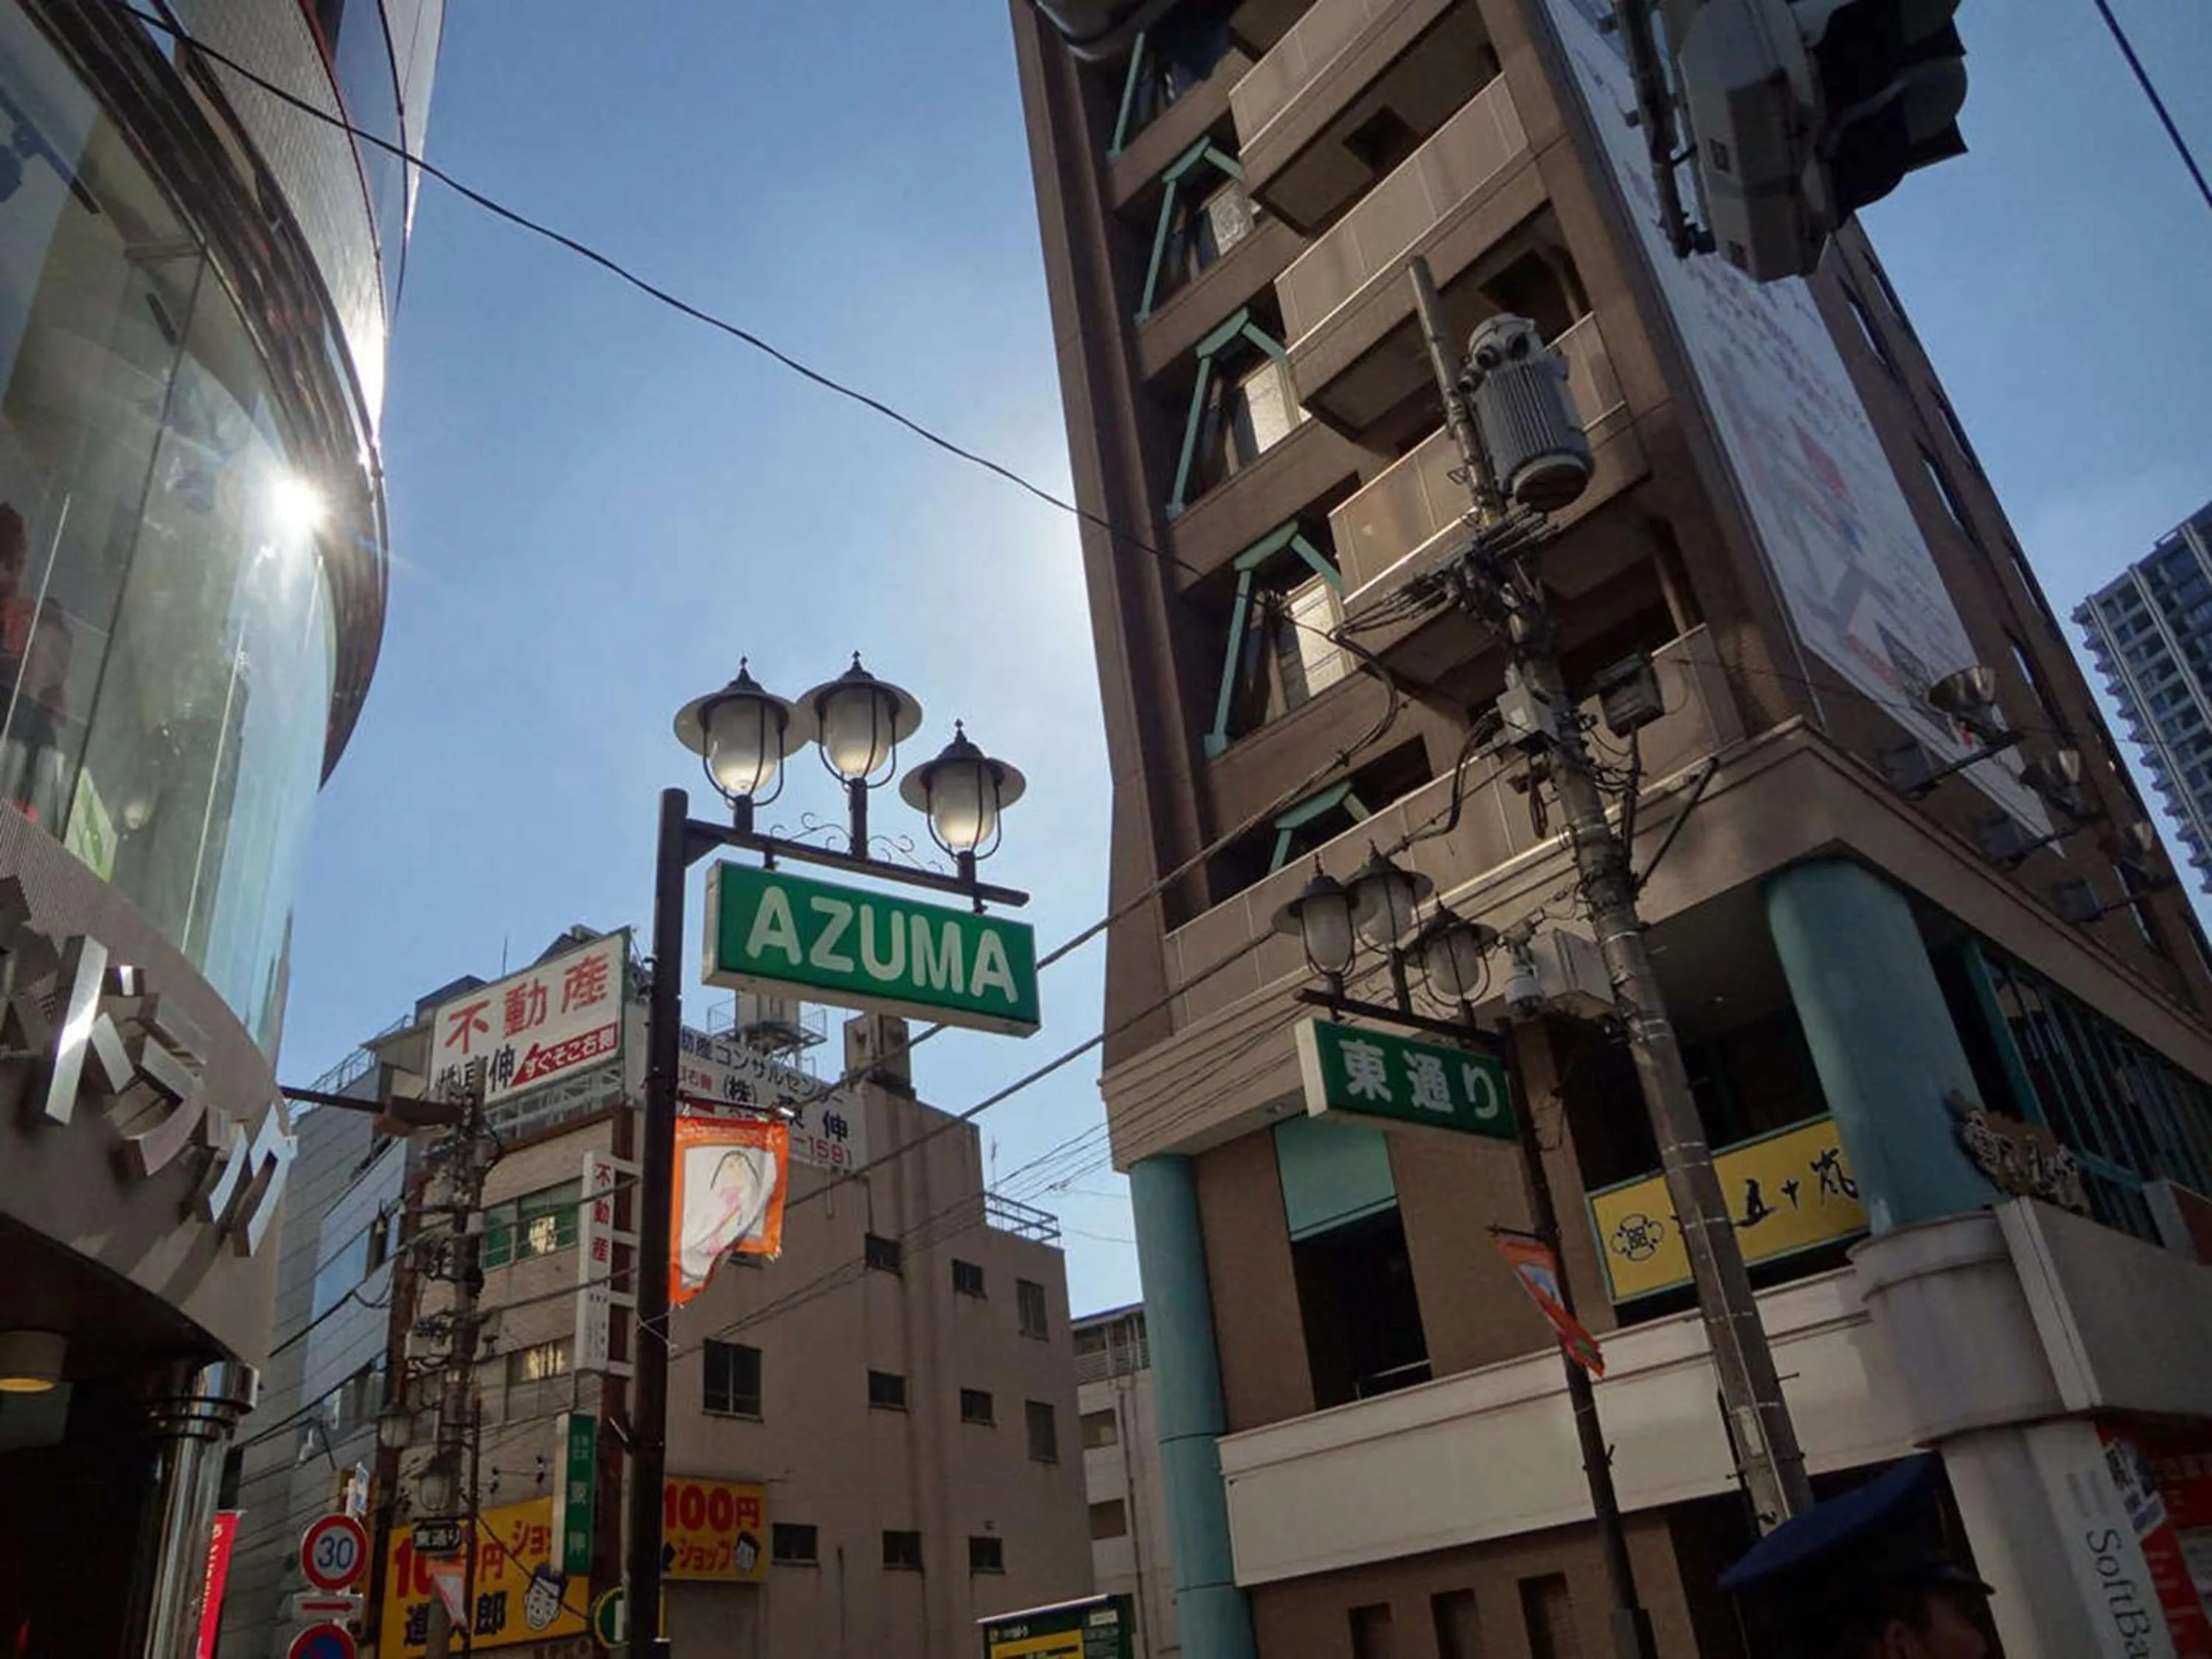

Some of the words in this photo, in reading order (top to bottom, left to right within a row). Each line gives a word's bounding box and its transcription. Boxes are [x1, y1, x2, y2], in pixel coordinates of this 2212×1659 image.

[745, 885, 1019, 1004] AZUMA
[445, 953, 610, 1054] 不動産
[1338, 1037, 1500, 1119] 東通り
[592, 1162, 611, 1264] 不動産
[318, 1536, 355, 1570] 30
[664, 1483, 761, 1532] 100円
